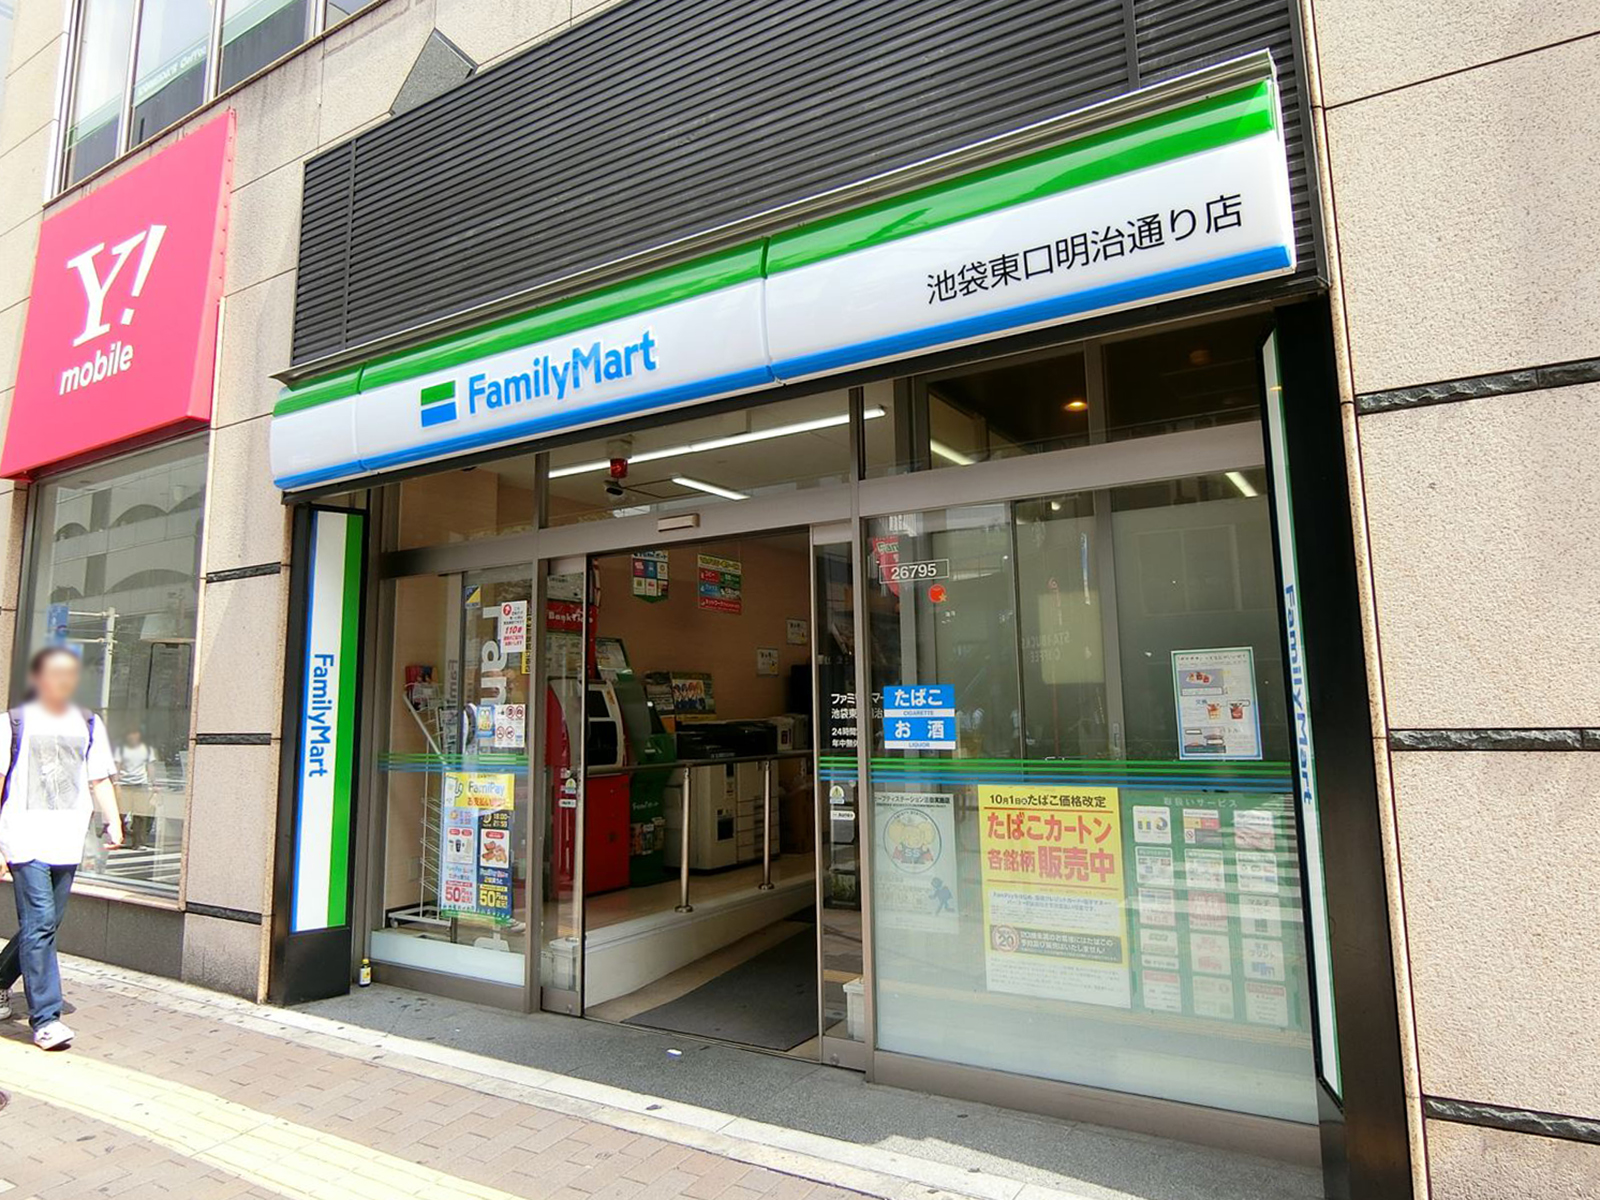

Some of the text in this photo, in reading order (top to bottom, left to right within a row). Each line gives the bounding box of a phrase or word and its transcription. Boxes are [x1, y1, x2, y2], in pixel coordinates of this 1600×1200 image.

[926, 193, 1243, 305] 池袋東口明治通り店
[66, 224, 168, 347] Y!
[58, 341, 134, 396] mobile
[468, 330, 657, 415] FamilyMart
[891, 563, 937, 580] 26795
[307, 653, 335, 778] FamilyMart
[894, 687, 943, 707] たばこ
[1285, 584, 1314, 805] FamilyMart
[894, 720, 944, 739] お酒
[468, 780, 505, 797] FamiPay
[987, 811, 1113, 844] たばこカートン
